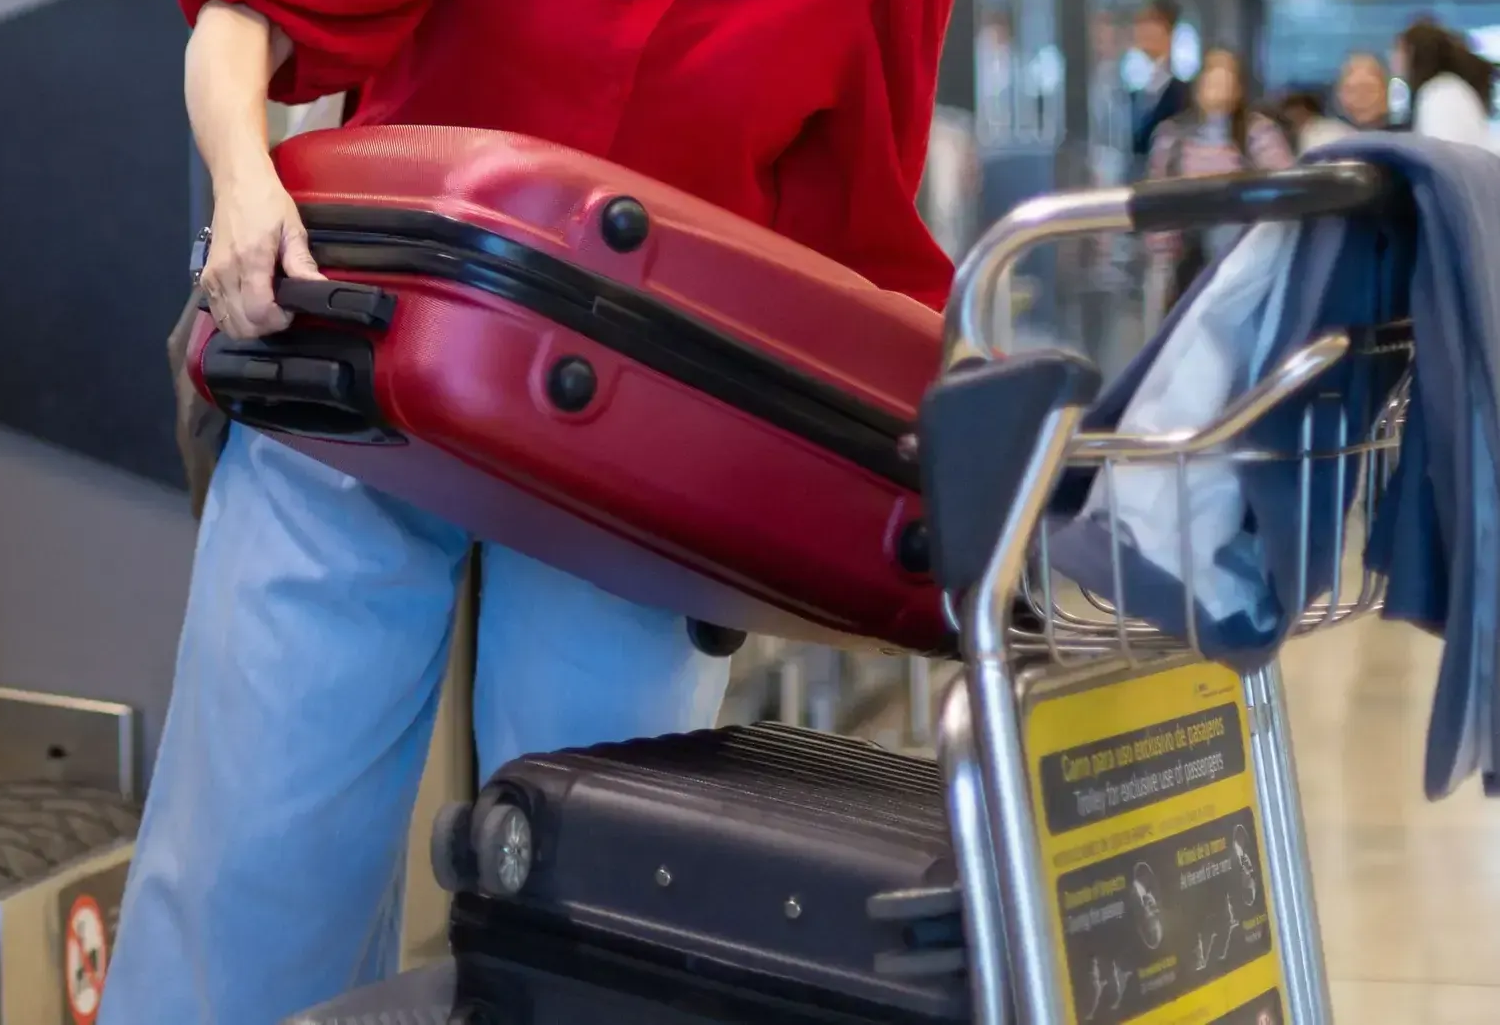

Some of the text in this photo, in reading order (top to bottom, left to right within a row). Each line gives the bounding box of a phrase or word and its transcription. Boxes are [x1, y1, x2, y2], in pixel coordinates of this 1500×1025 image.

[1133, 727, 1175, 763] exclusivo
[1174, 722, 1187, 749] de
[1187, 715, 1225, 751] pasajeros
[1106, 780, 1121, 806] for
[1121, 770, 1159, 802] exclusive
[1160, 768, 1175, 790] use
[1174, 758, 1184, 786] of
[1183, 752, 1224, 788] passengers
